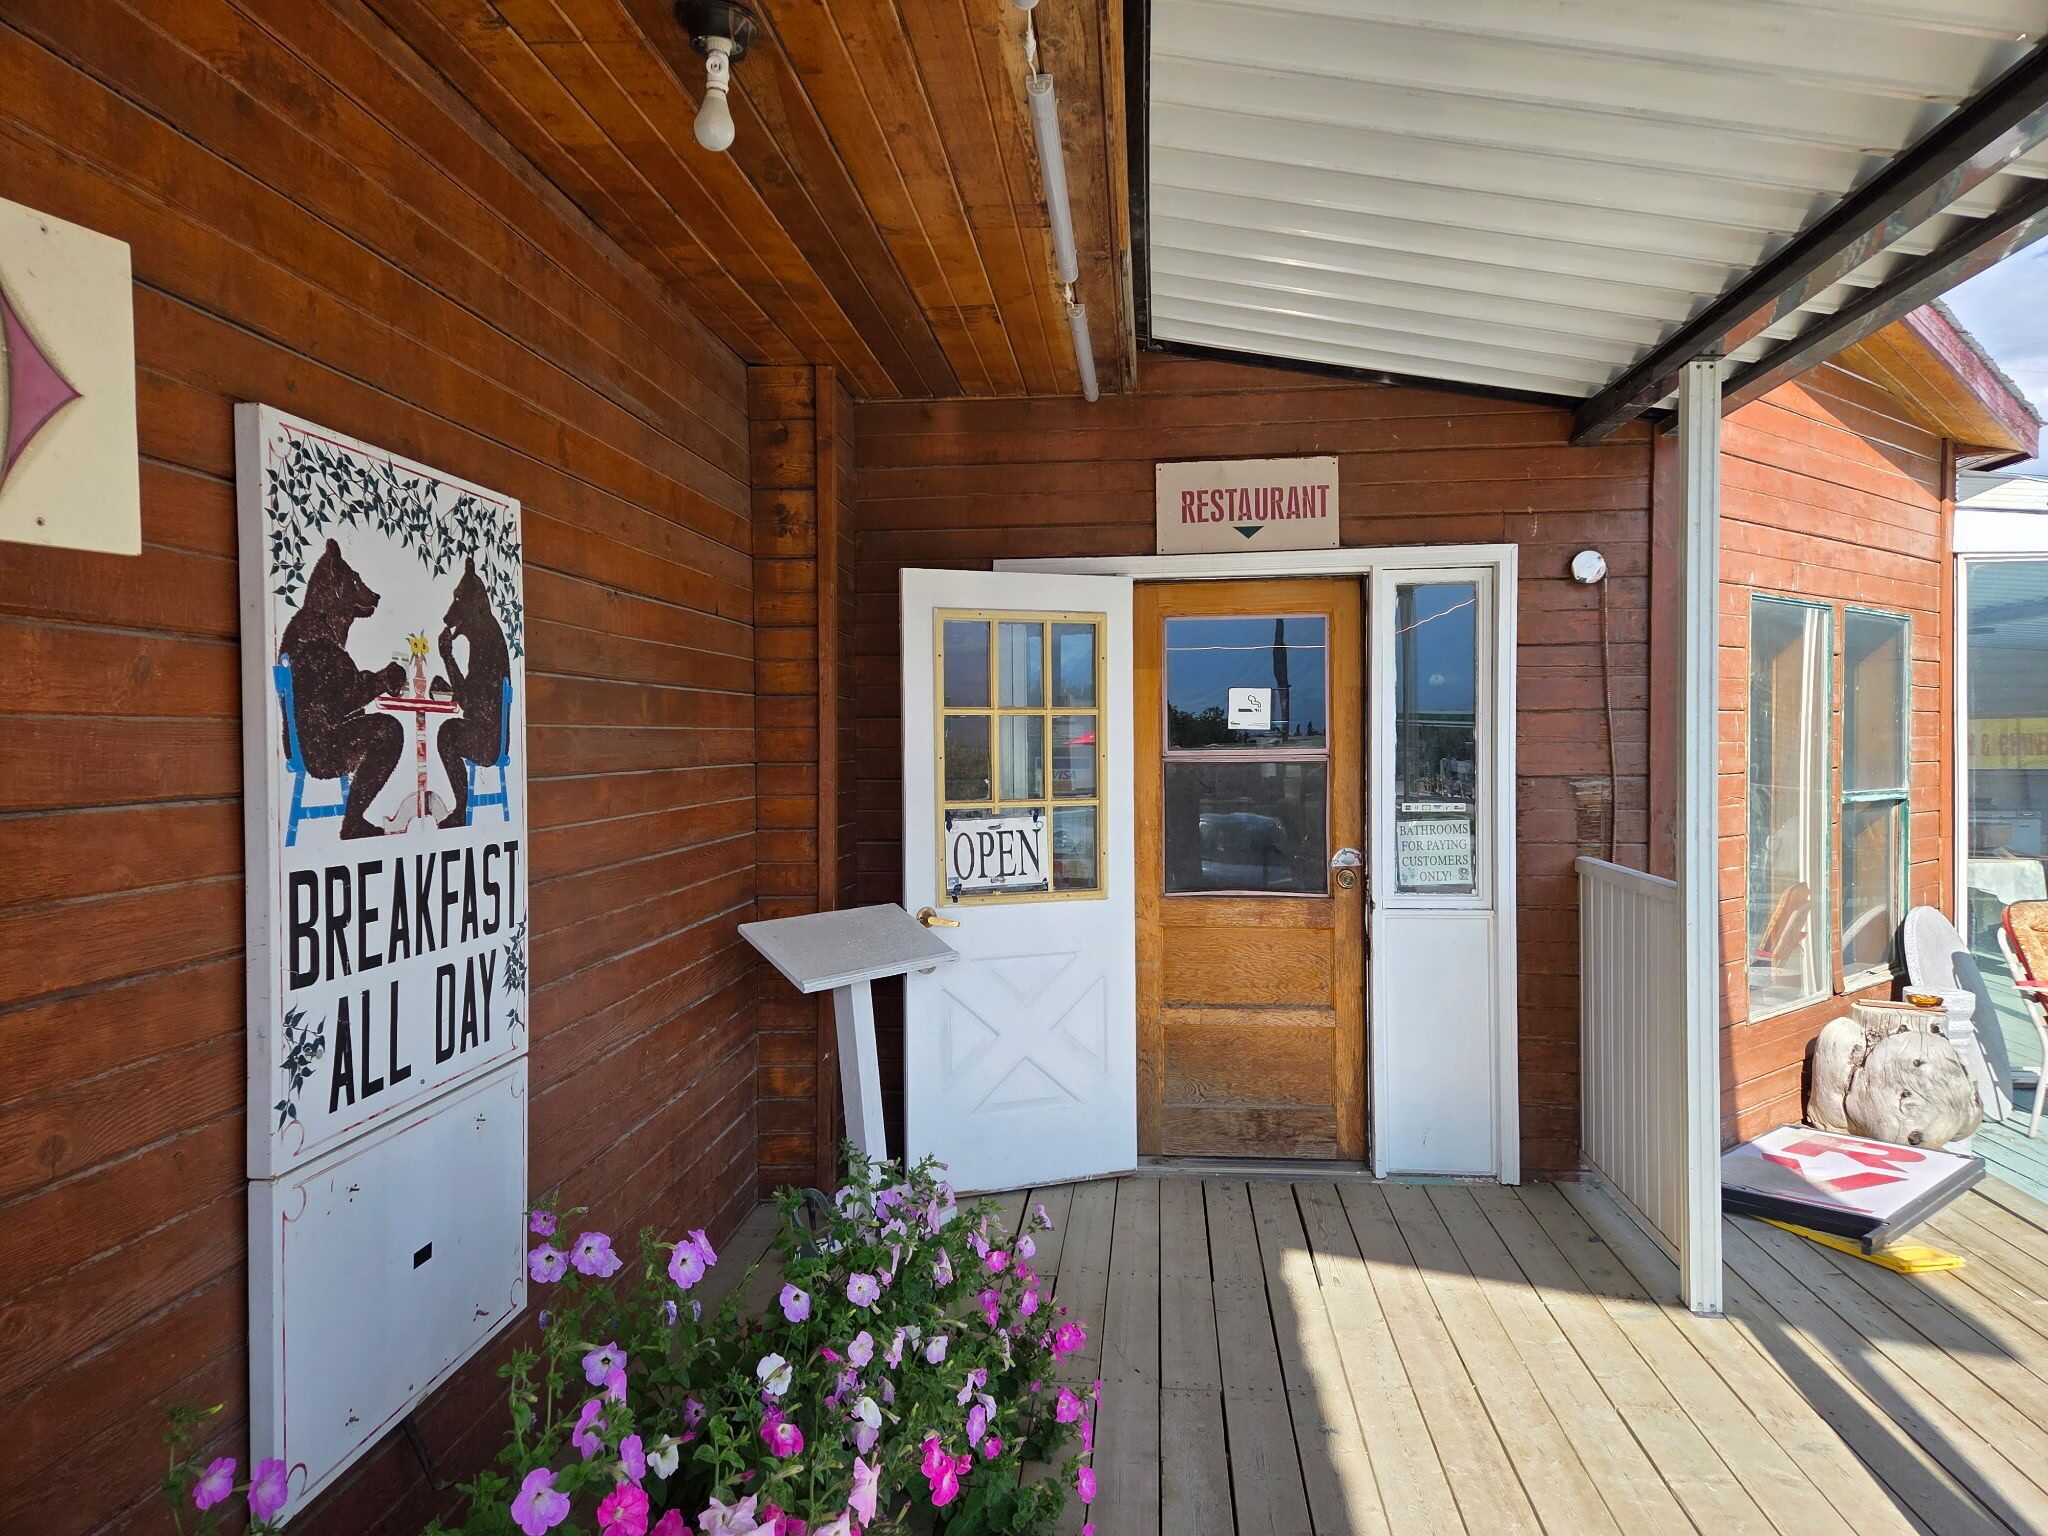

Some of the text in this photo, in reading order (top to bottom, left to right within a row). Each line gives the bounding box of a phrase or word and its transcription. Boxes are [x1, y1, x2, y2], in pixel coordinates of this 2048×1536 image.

[1181, 485, 1330, 524] RESTAURANT
[1400, 824, 1469, 836] BATHROOMS
[953, 828, 1041, 881] OPEN
[1402, 839, 1467, 852] FOR PAYING
[1402, 855, 1469, 867] CUSTOMERS
[1419, 871, 1453, 882] ONLY!
[289, 840, 519, 991] BREAKFAST
[328, 948, 497, 1115] ALL DAY
